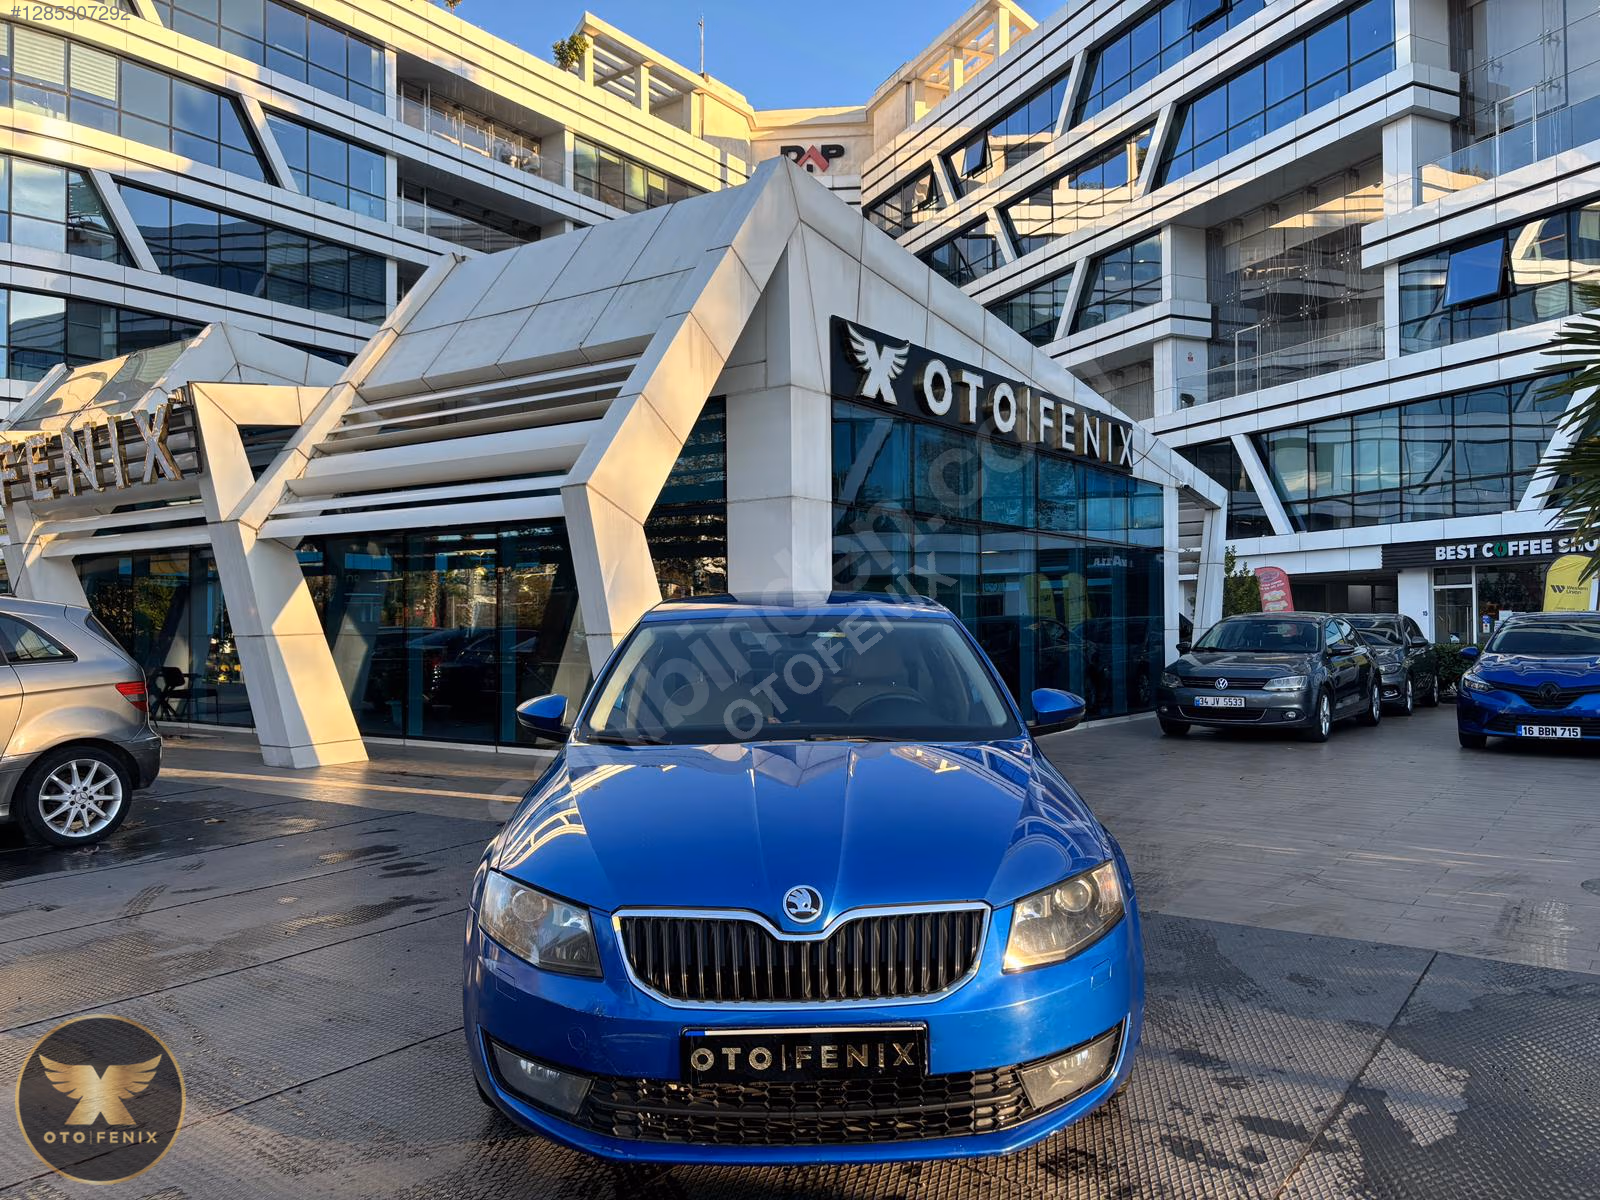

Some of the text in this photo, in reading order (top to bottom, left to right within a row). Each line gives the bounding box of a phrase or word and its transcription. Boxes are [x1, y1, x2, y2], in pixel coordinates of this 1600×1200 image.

[1435, 543, 1477, 561] BEST
[1481, 538, 1553, 558] COFFEE
[1200, 697, 1243, 707] 34 JV 5533
[1523, 726, 1579, 737] 16 BBN 715
